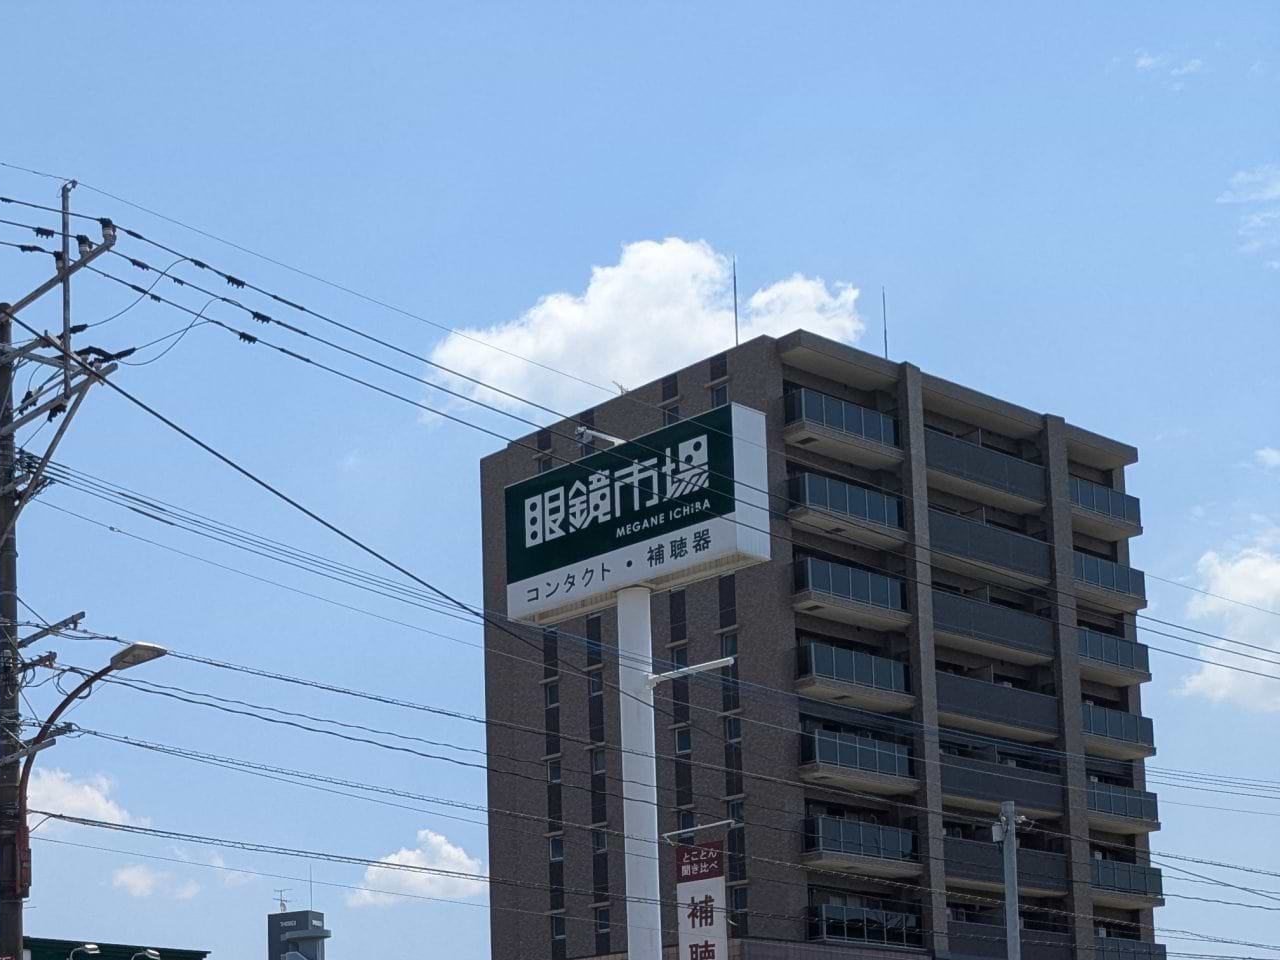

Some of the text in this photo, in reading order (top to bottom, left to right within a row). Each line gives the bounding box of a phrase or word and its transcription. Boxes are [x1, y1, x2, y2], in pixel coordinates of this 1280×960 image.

[524, 434, 709, 548] 眼鏡市場
[616, 513, 665, 538] MEGANE
[682, 849, 717, 863] とことん
[681, 861, 719, 876] 聞き比べ
